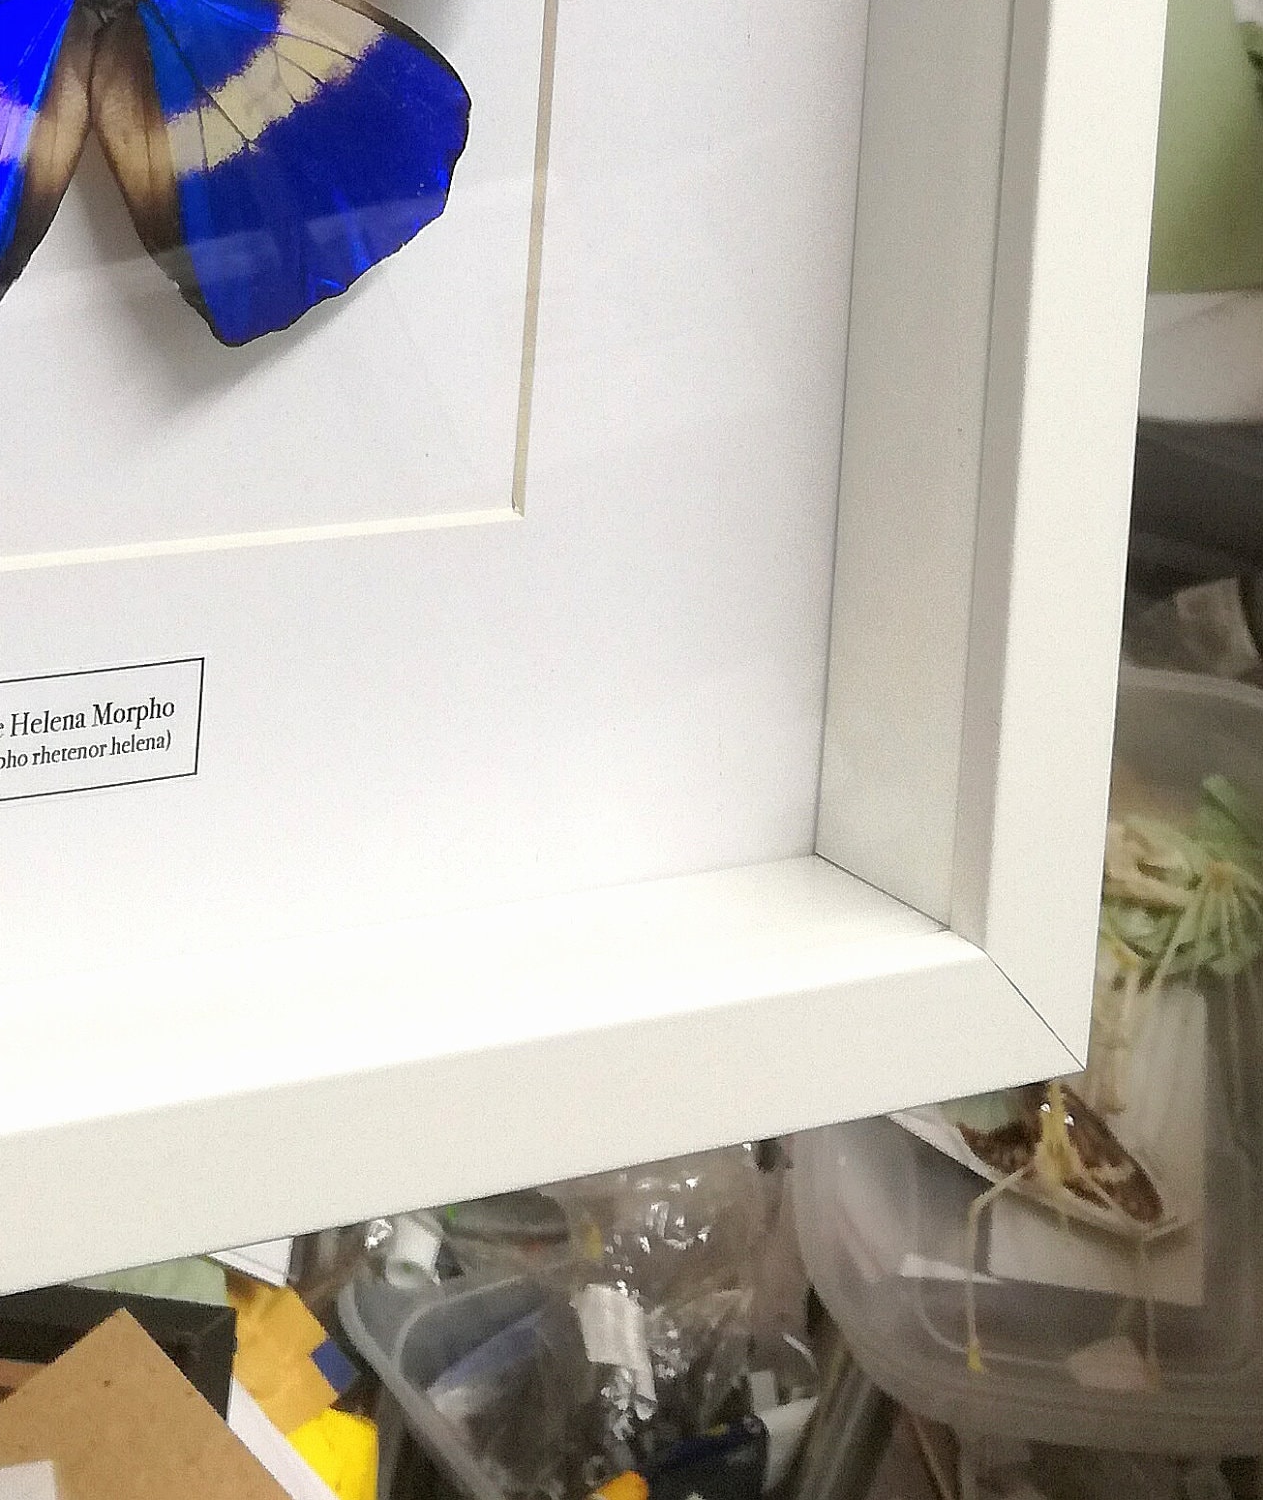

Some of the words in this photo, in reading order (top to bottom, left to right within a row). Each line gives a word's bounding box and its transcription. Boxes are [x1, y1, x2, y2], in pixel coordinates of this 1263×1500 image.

[10, 710, 87, 738] Helena
[92, 696, 175, 730] Morpho
[32, 743, 109, 766] rhetenor
[109, 729, 172, 756] helena)
